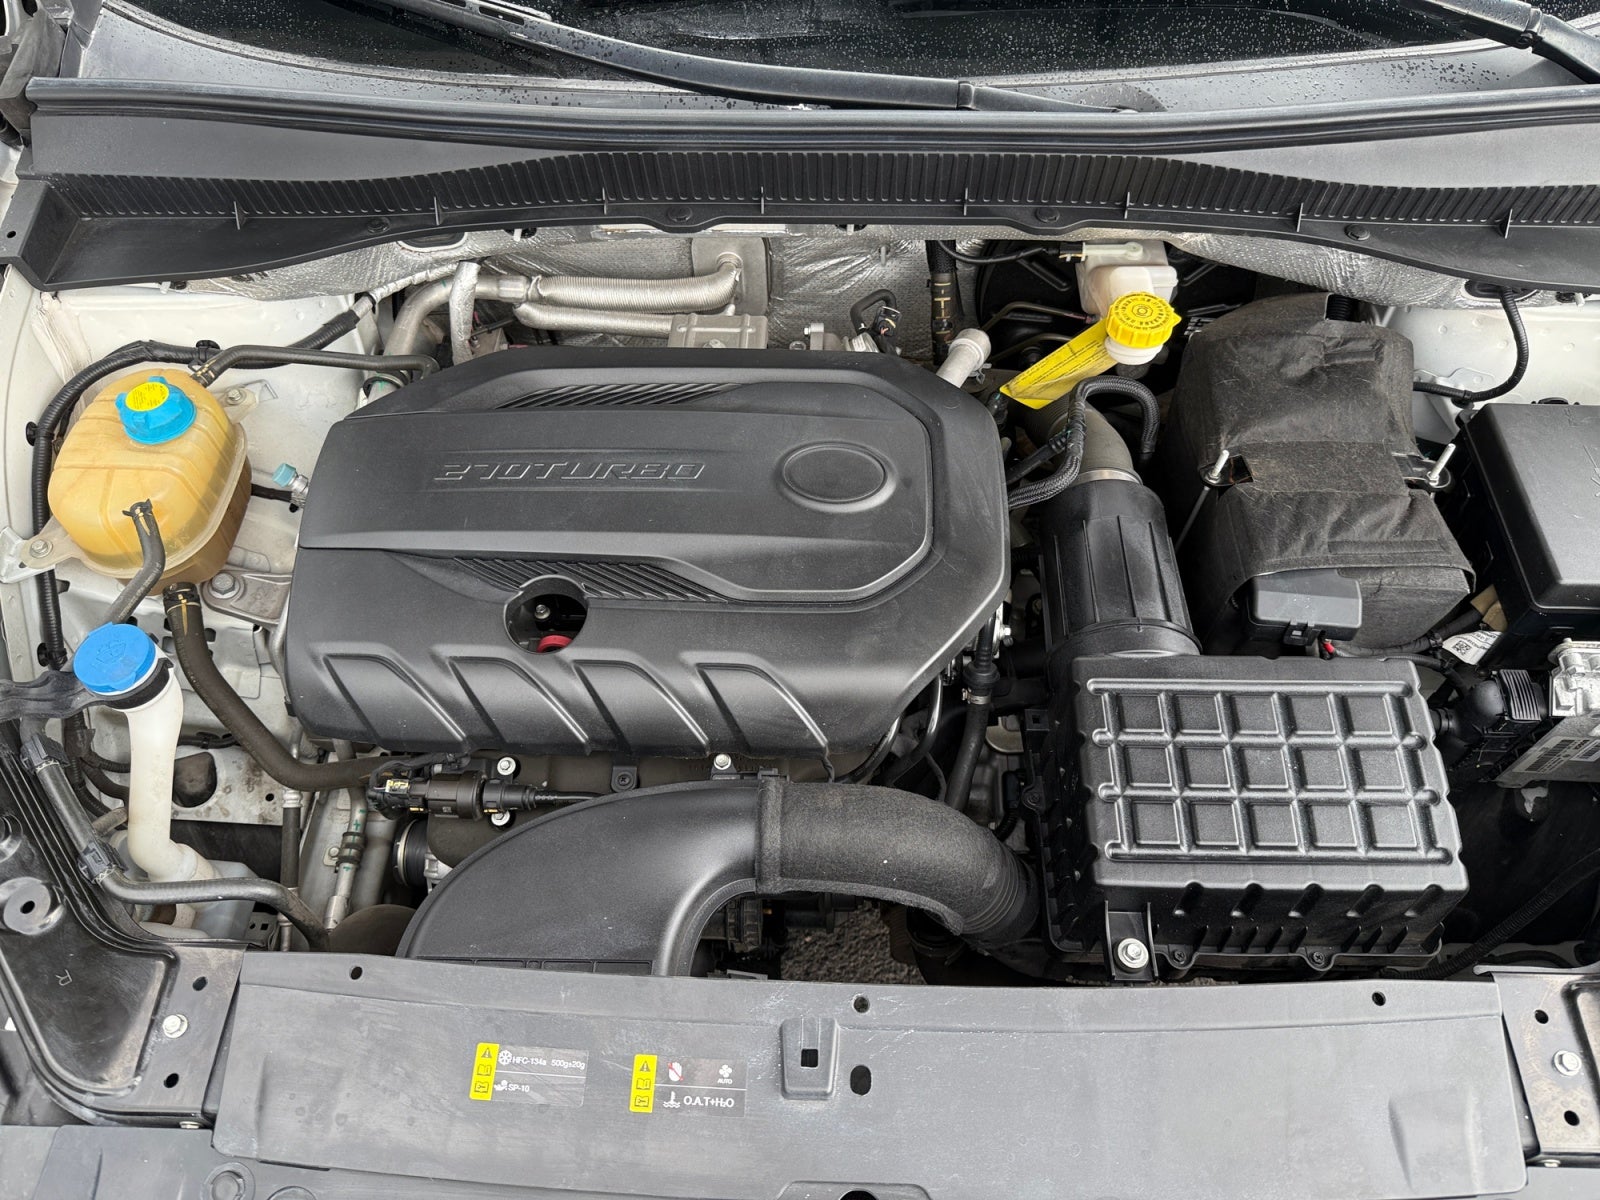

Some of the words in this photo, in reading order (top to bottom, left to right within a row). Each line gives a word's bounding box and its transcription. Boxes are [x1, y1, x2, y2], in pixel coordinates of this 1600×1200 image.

[433, 462, 706, 481] 270TURBO
[511, 1055, 547, 1067] HFC-134a
[550, 1059, 586, 1070] 500g±20g
[507, 1083, 530, 1093] SP-10
